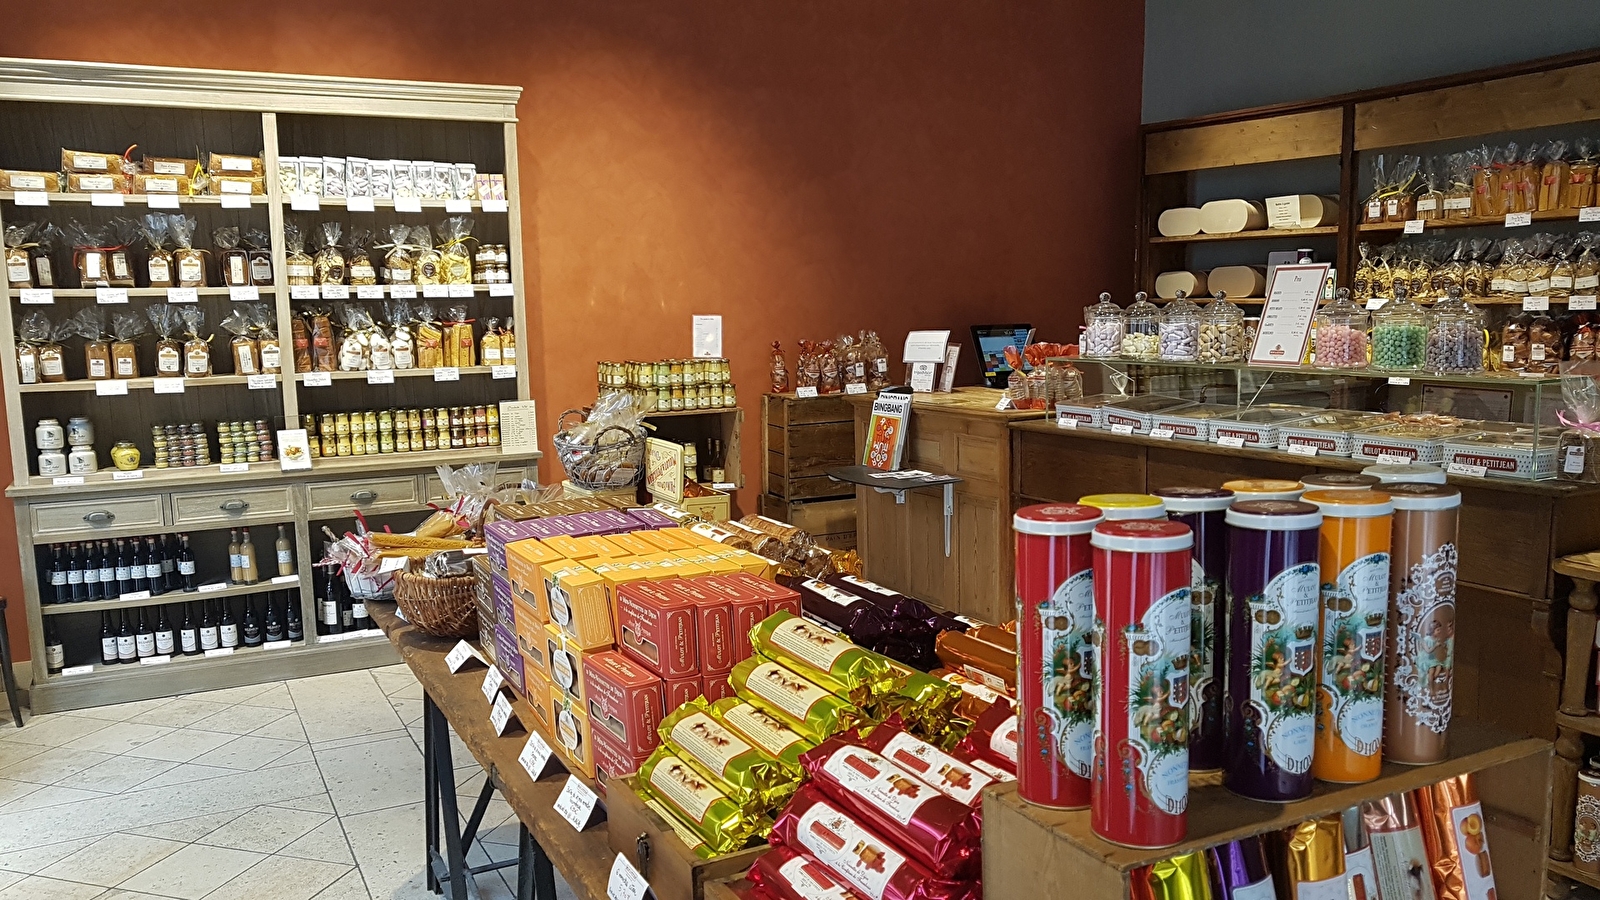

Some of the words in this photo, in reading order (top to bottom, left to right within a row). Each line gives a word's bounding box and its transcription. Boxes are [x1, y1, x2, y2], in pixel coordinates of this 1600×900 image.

[1364, 447, 1380, 455] MULOT
[1388, 450, 1415, 459] PETITJEAN
[1456, 456, 1475, 466] MULOT
[1483, 459, 1515, 470] PETITJEAN
